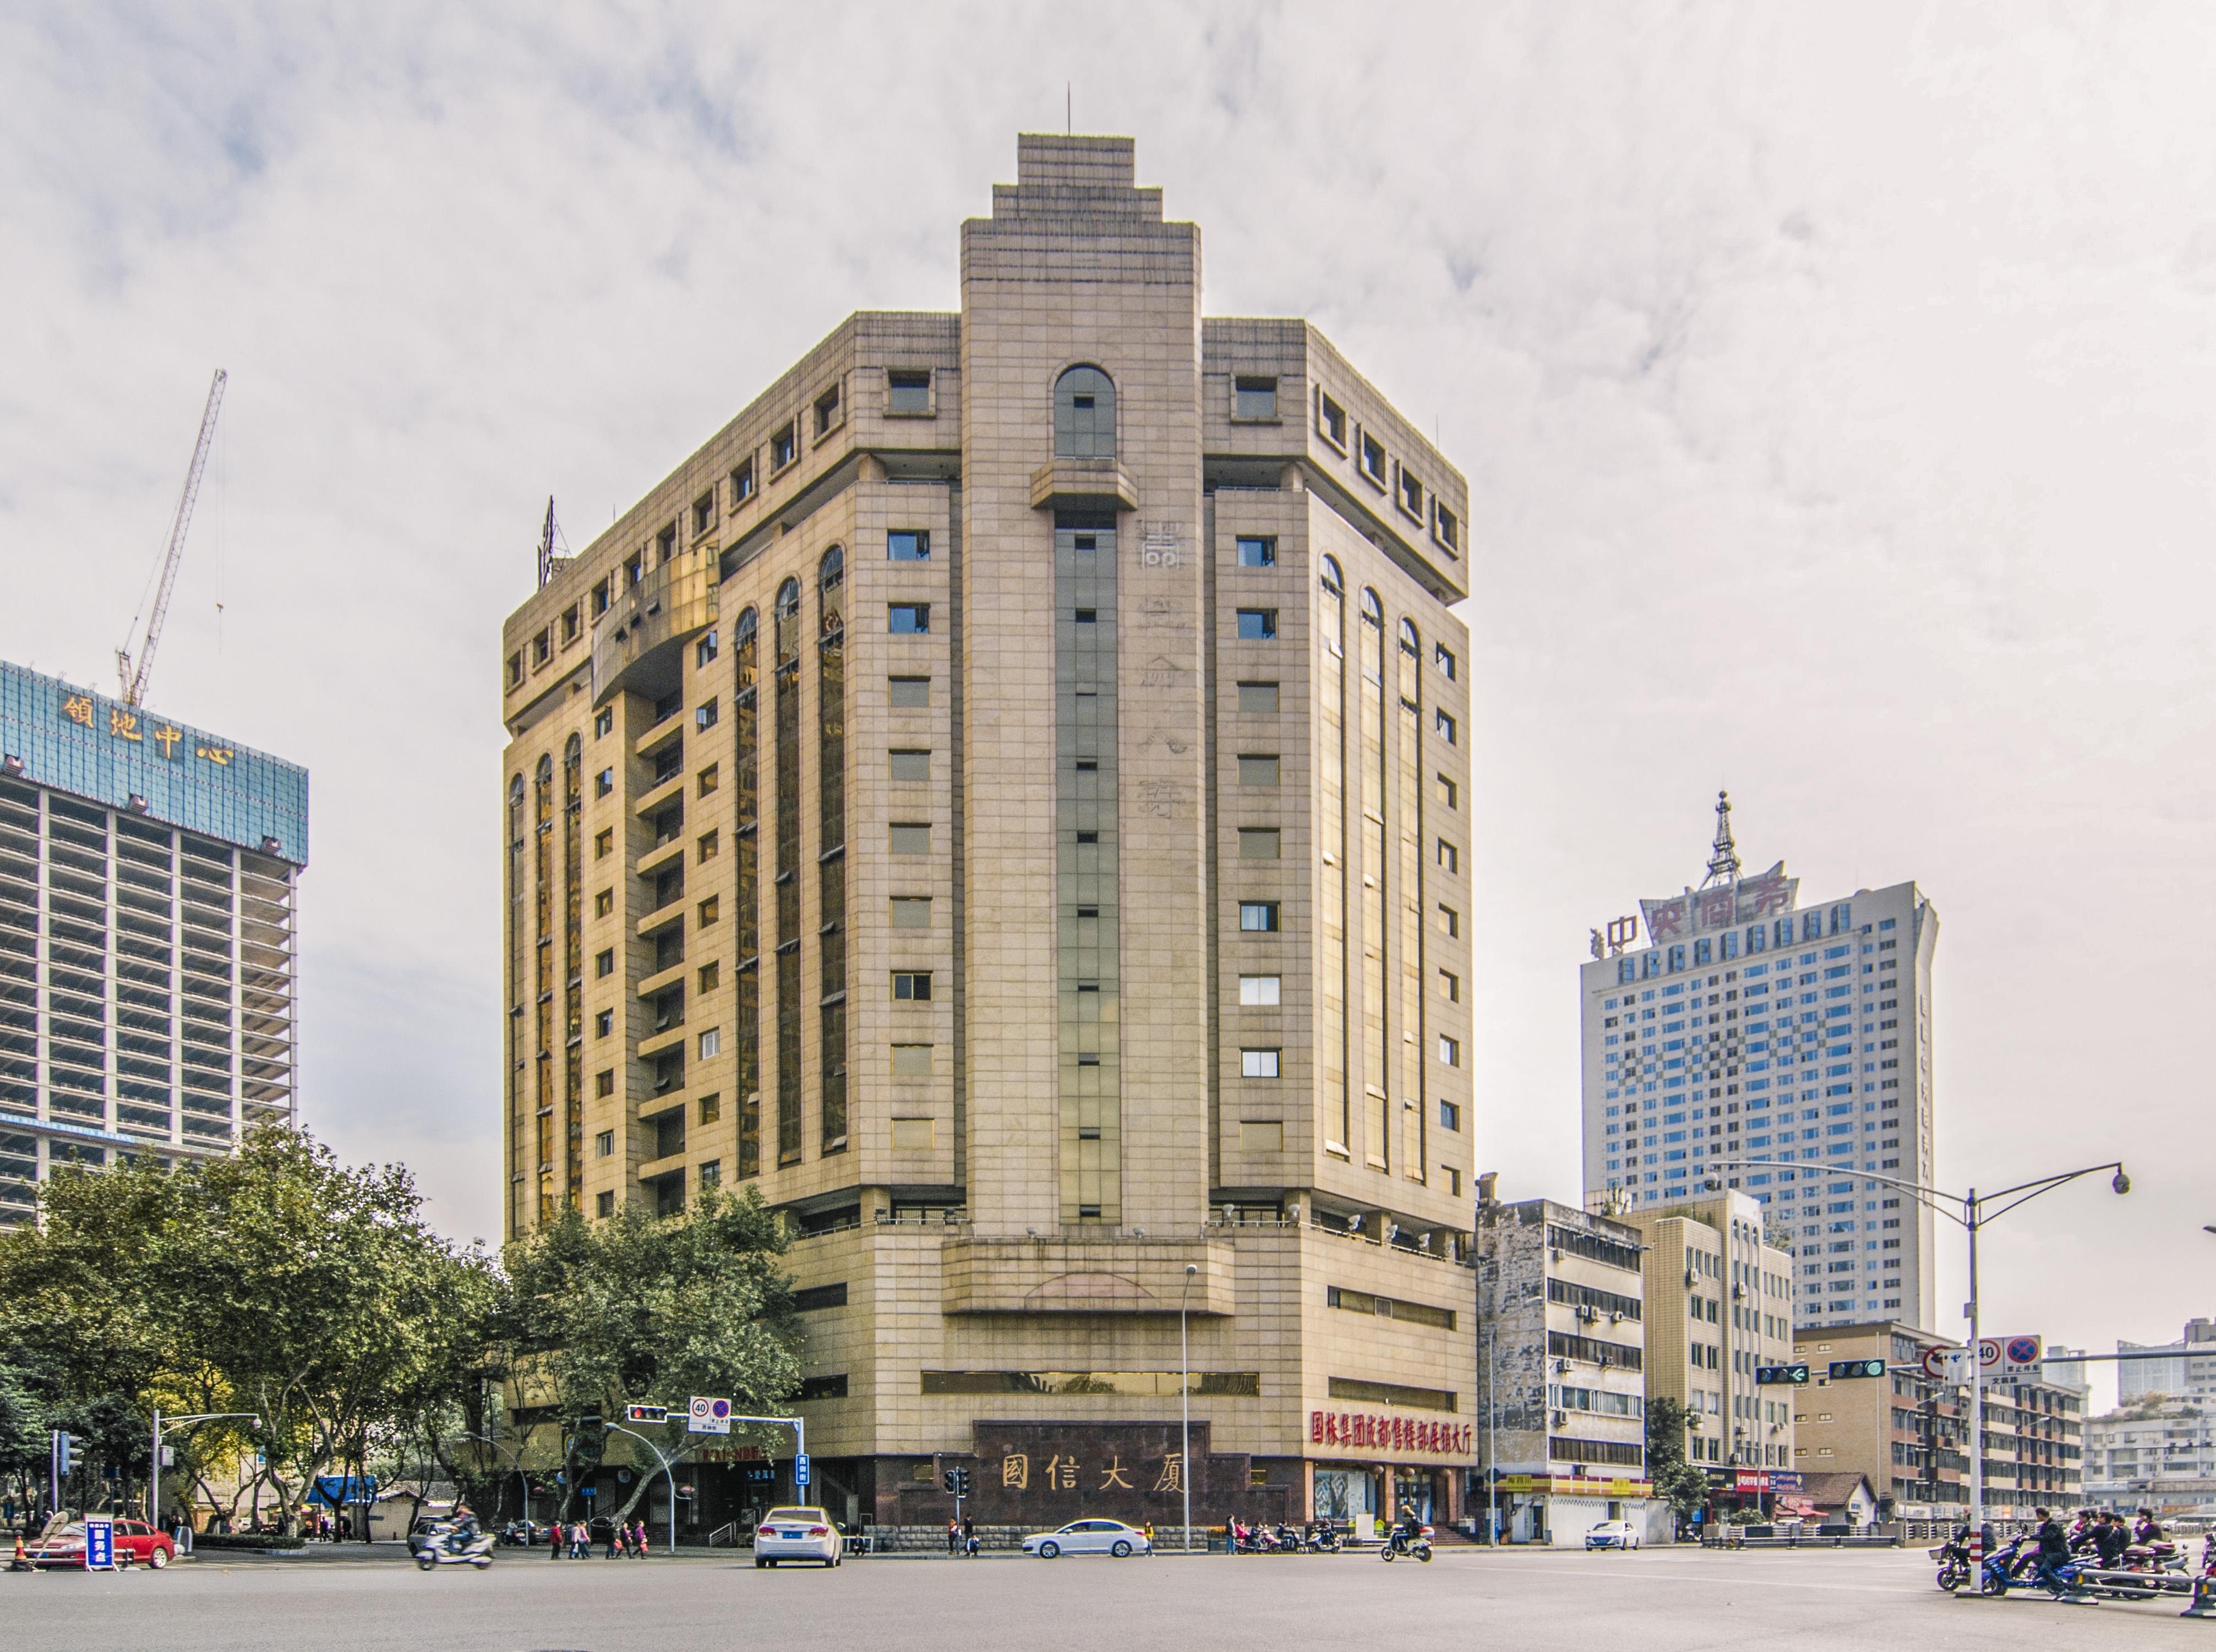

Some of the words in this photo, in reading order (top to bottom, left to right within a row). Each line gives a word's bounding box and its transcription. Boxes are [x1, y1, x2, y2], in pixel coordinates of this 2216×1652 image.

[61, 696, 235, 766] 領地中心
[1607, 876, 1789, 947] 中央商务
[1979, 1346, 1994, 1359] 40
[695, 1404, 706, 1413] 40
